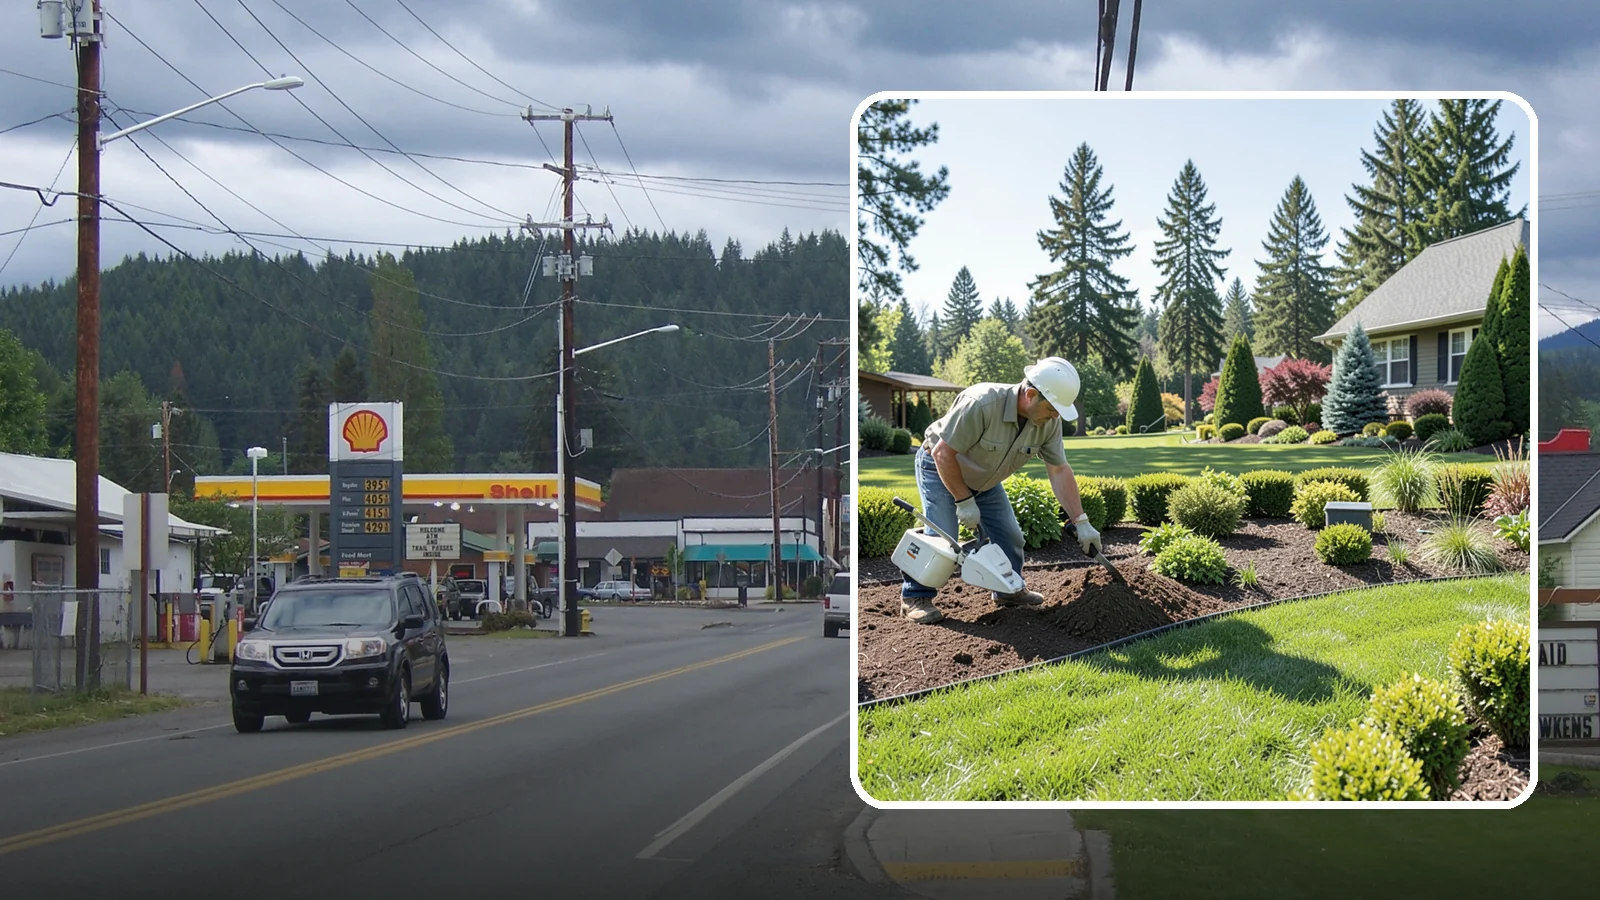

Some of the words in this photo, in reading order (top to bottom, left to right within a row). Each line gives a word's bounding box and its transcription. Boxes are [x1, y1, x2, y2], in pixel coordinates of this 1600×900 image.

[366, 480, 384, 490] 395
[490, 484, 547, 499] Shell
[366, 494, 384, 504] 405
[366, 508, 383, 518] 415
[366, 522, 384, 533] 429
[1539, 643, 1566, 666] AID
